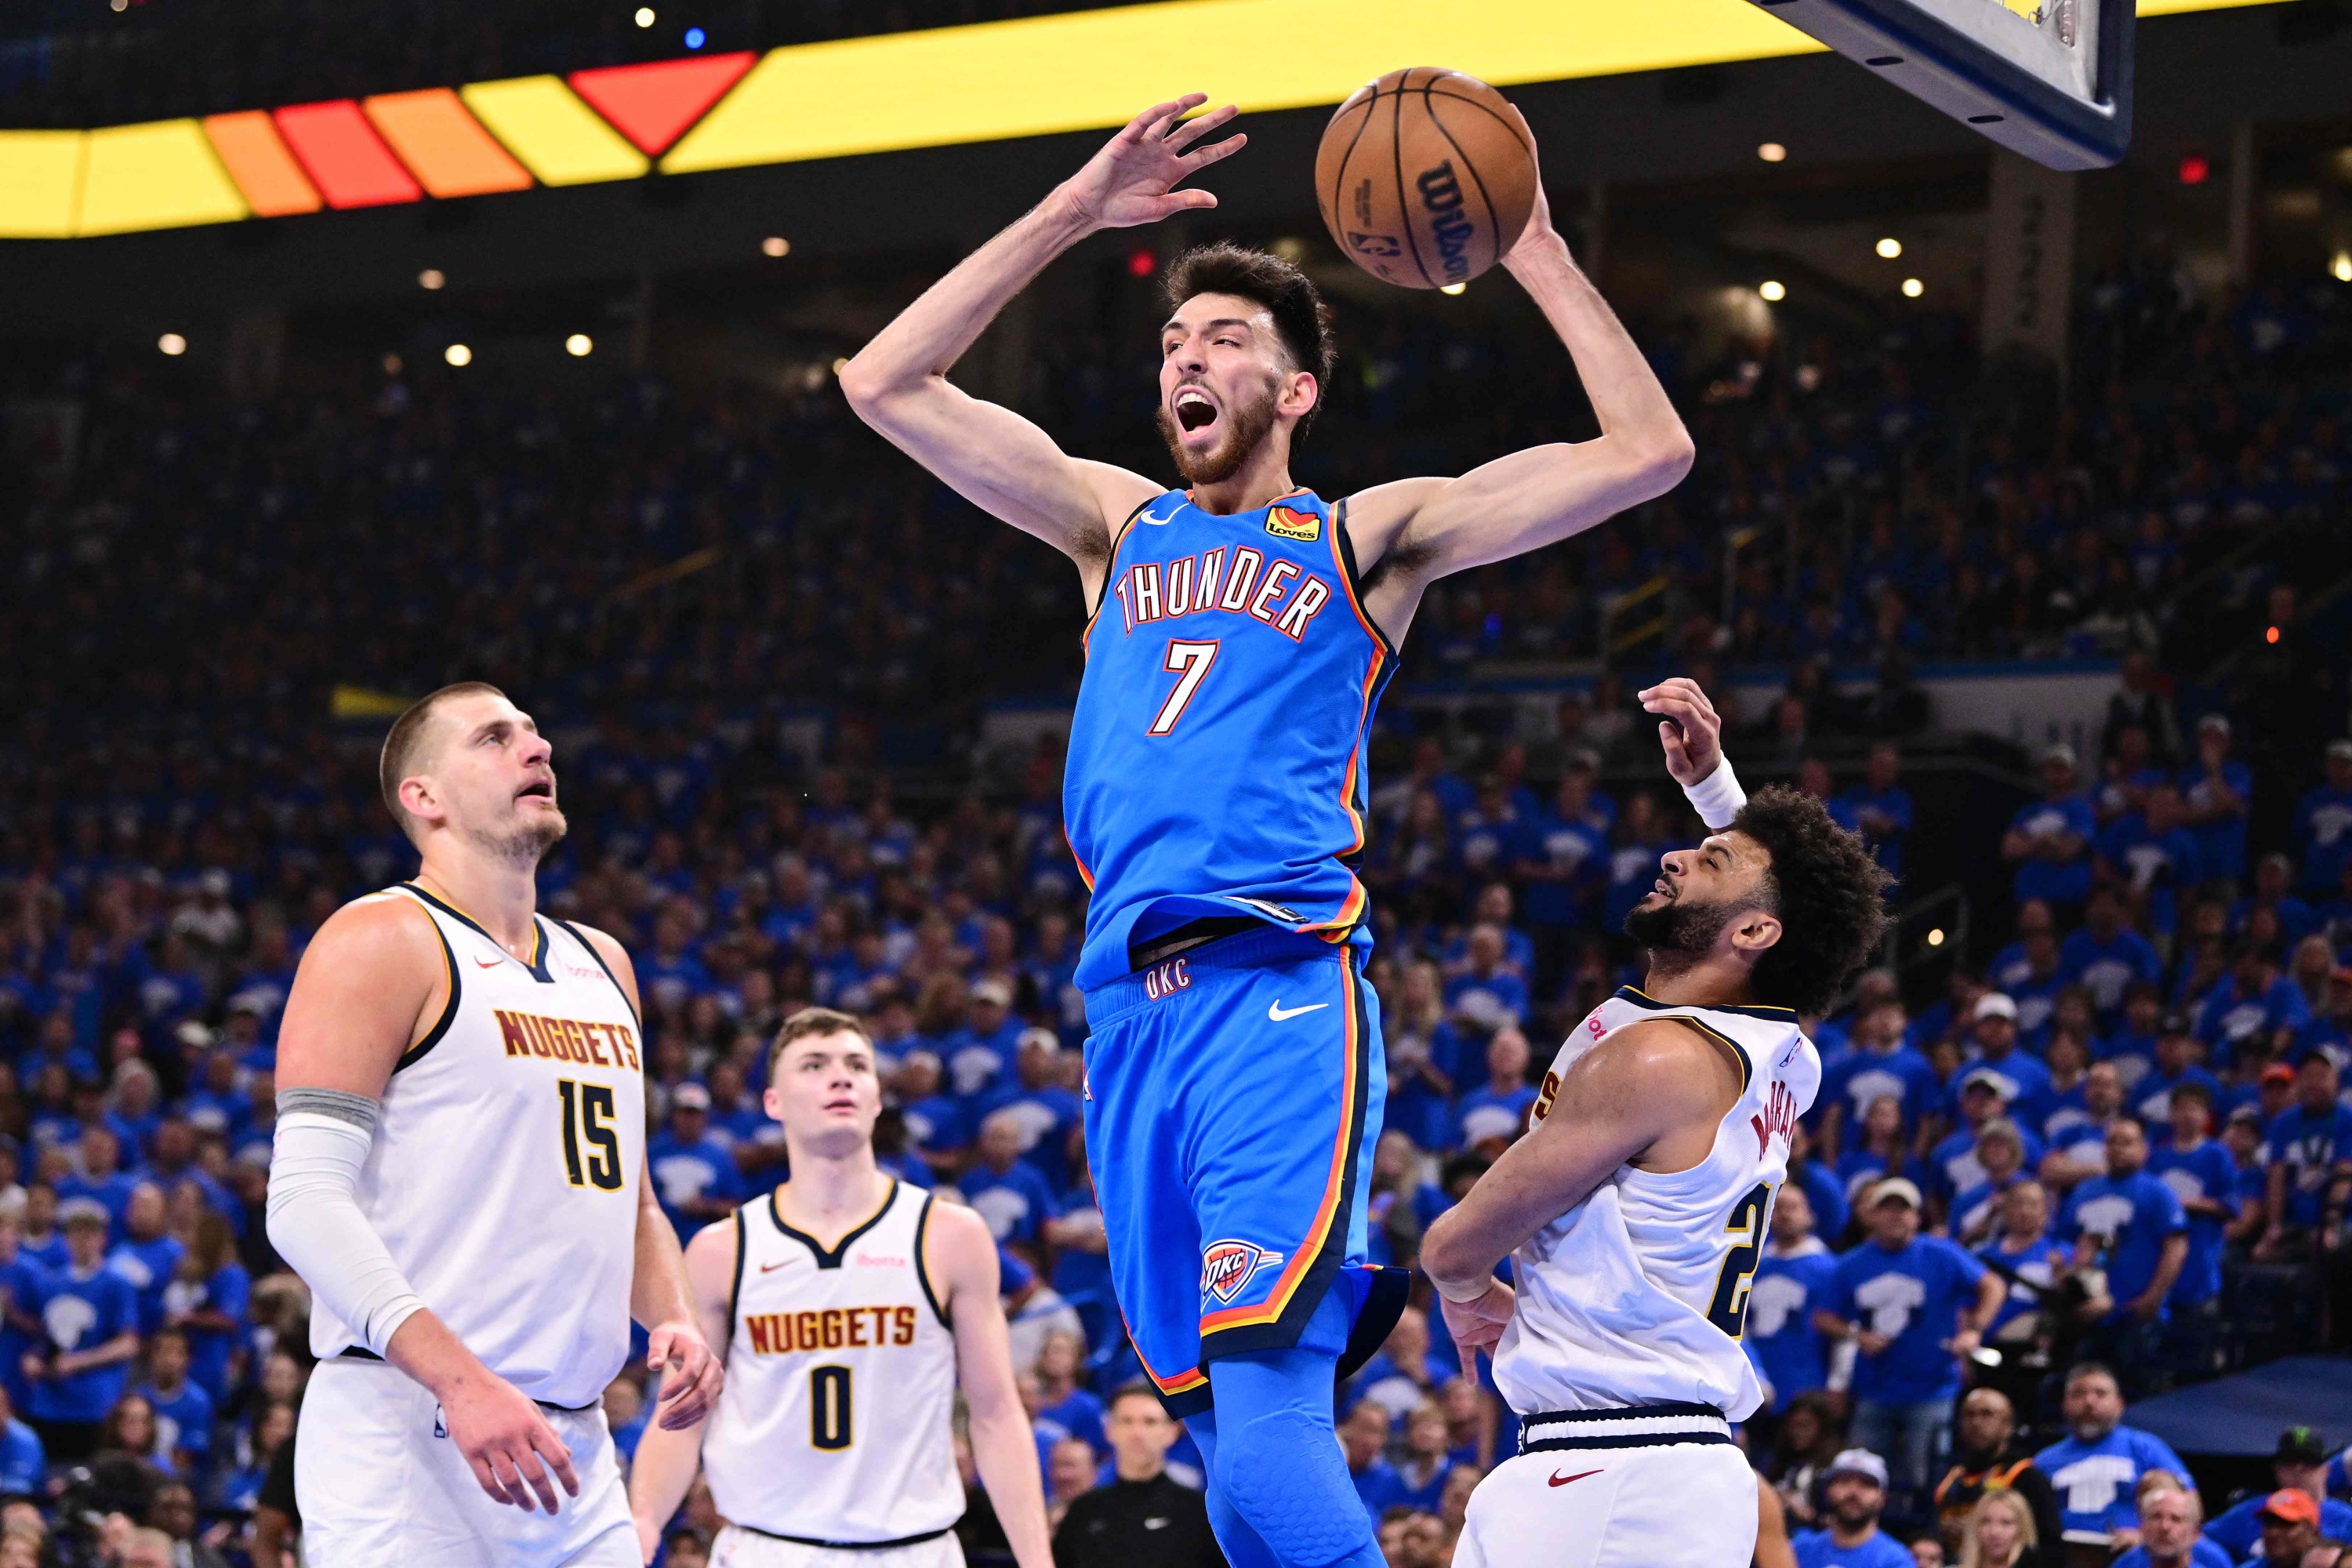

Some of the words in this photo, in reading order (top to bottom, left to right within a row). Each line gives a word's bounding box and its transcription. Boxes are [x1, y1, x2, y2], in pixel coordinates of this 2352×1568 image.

[1115, 545, 1331, 644] THUNDER
[1145, 638, 1221, 737] 7
[1145, 955, 1192, 1001] OKC
[494, 1008, 640, 1073] NUGGETS
[557, 1077, 624, 1193] 15
[1203, 1251, 1246, 1296] OKC
[746, 1305, 916, 1356] NUGGETS
[810, 1363, 854, 1453] 0
